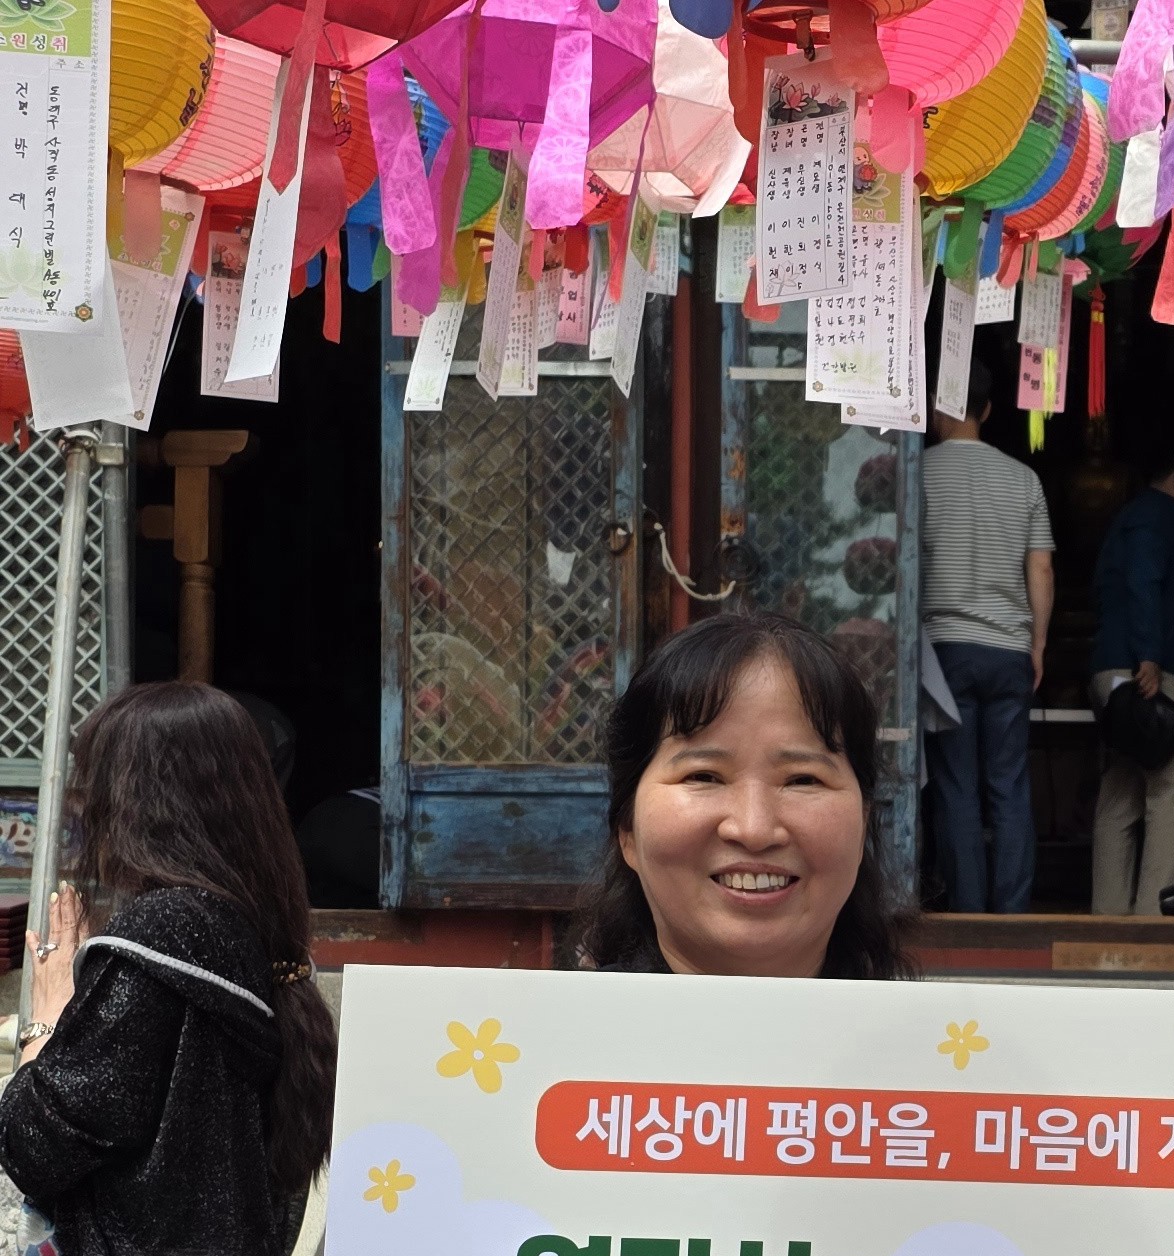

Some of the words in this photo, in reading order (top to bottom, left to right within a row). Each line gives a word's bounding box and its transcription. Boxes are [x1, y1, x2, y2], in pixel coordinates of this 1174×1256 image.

[576, 1095, 747, 1161] 세상에
[767, 1099, 951, 1169] 평안을,
[976, 1107, 1140, 1174] 마음에
